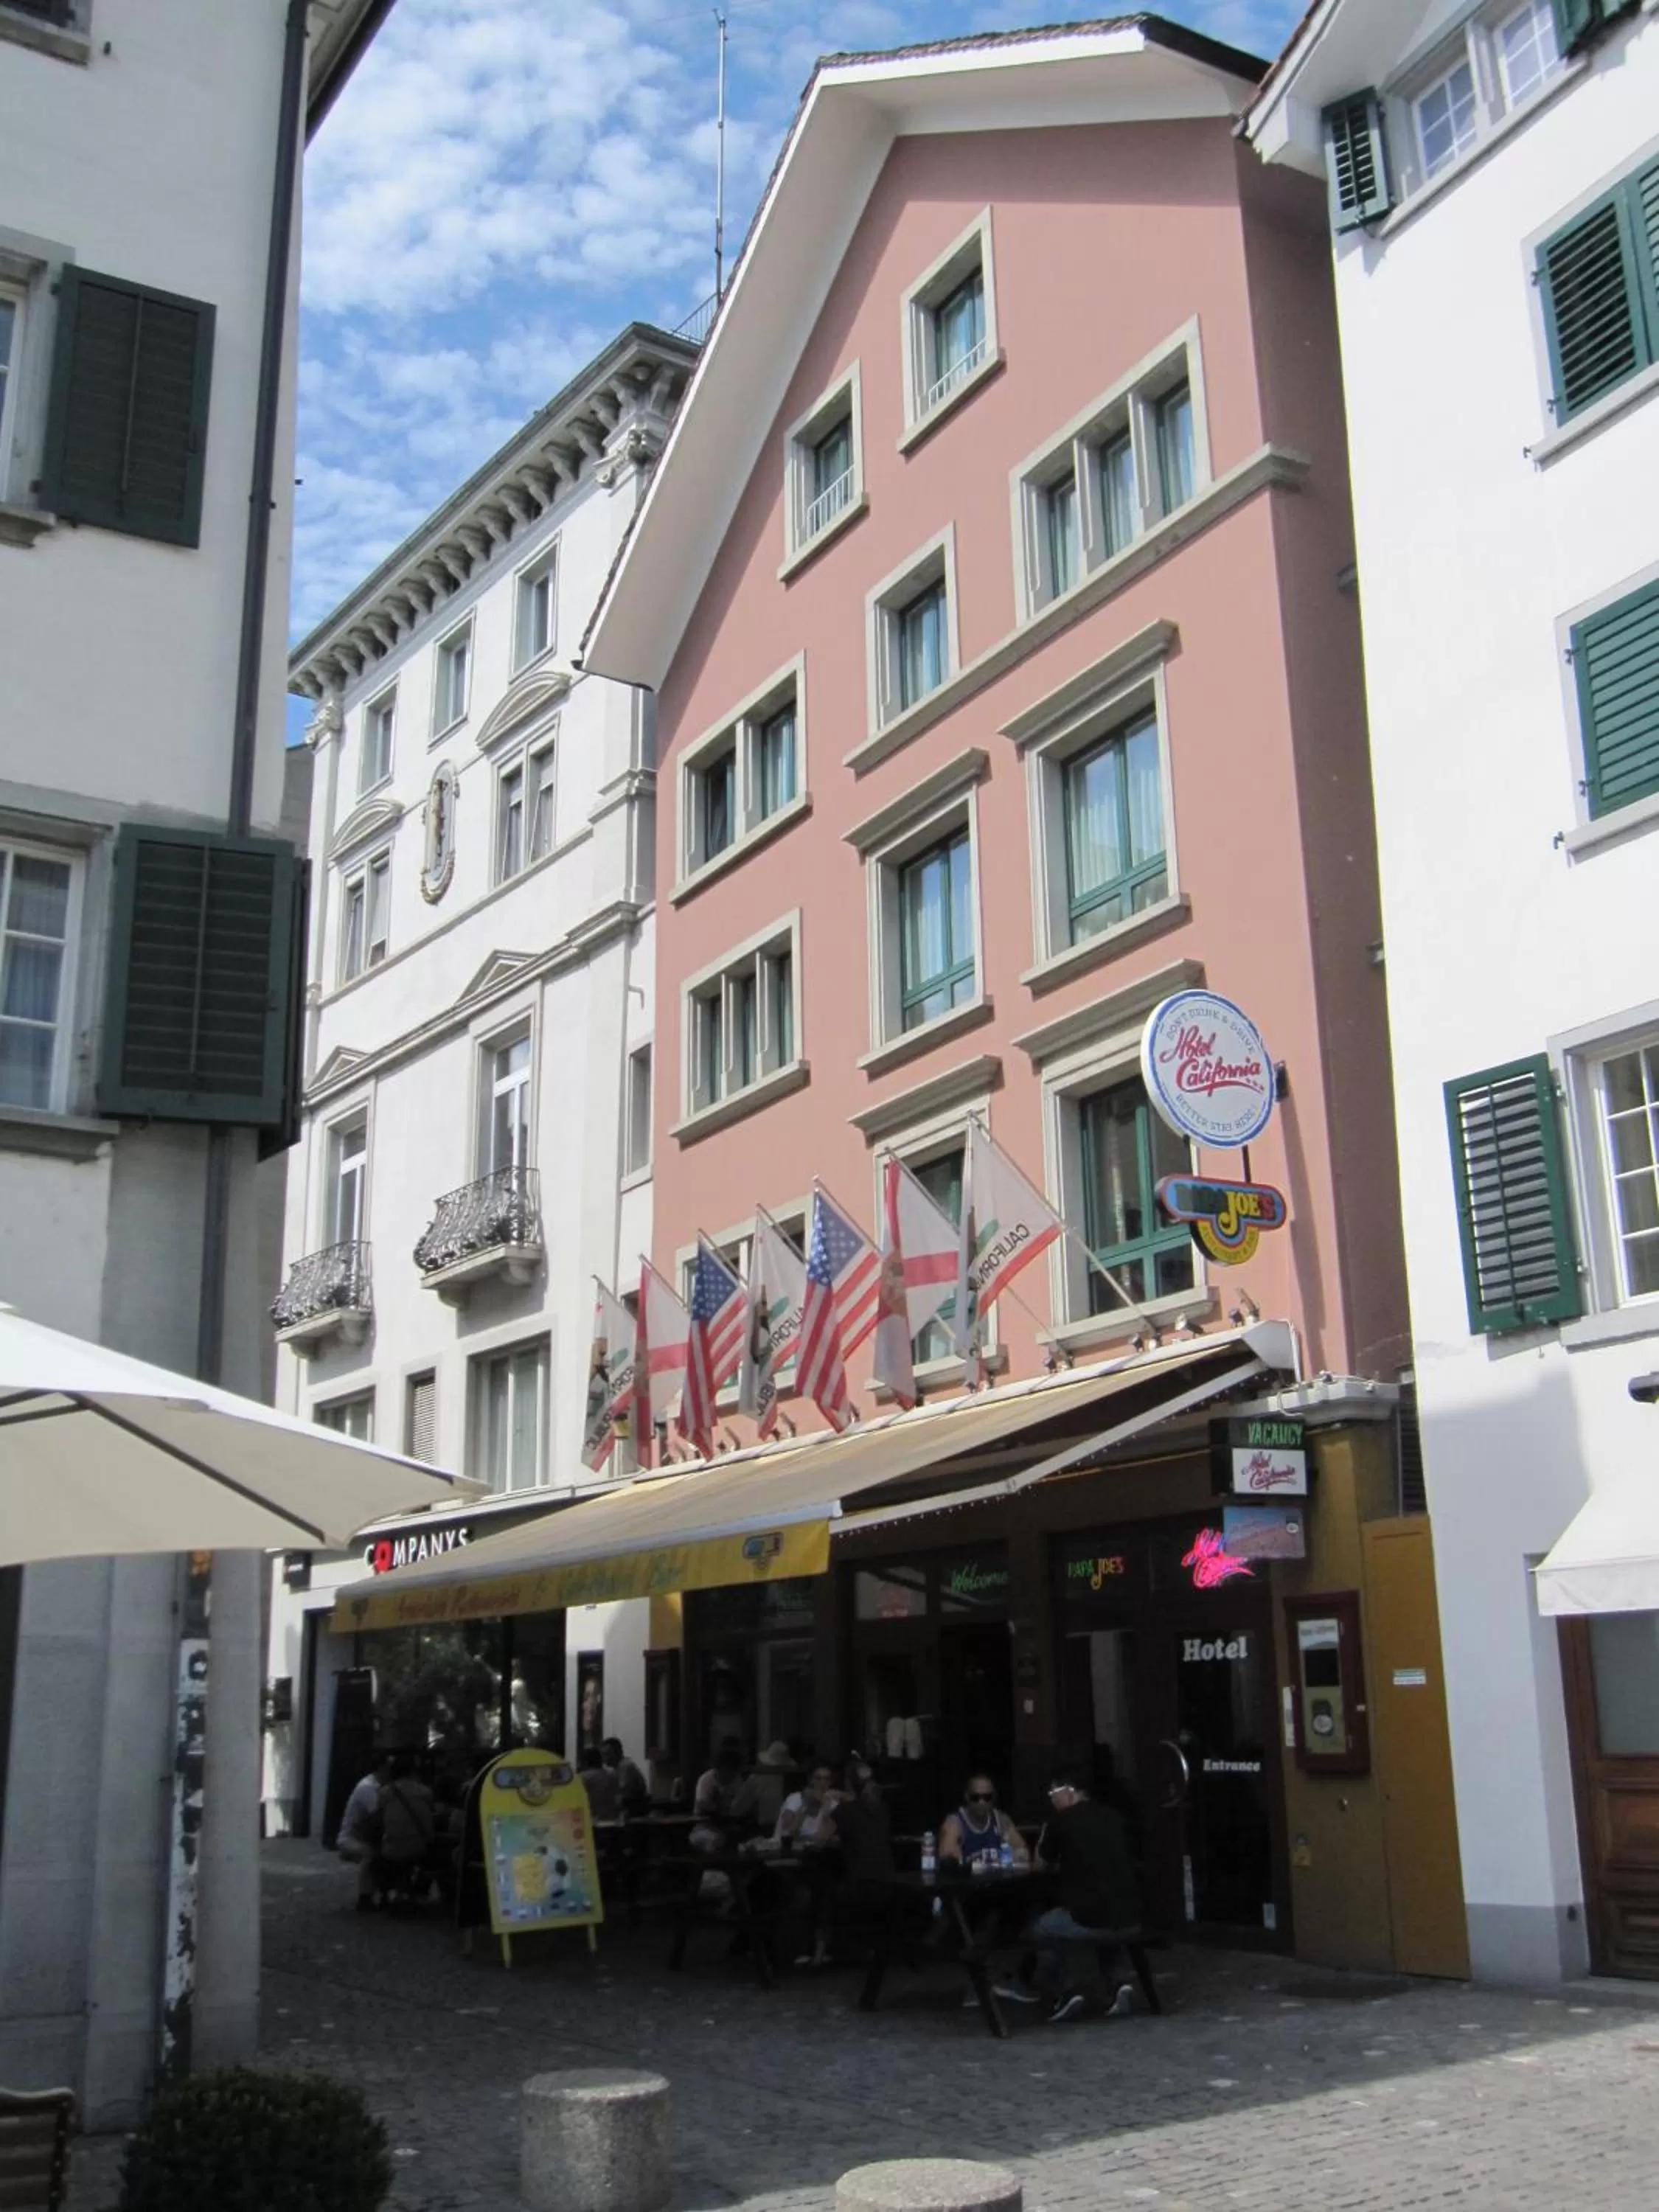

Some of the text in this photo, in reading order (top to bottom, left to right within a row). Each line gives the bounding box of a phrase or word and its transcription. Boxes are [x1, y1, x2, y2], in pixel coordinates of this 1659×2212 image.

[1159, 1024, 1217, 1064] Hotel
[1175, 1055, 1265, 1097] California
[1248, 1422, 1303, 1446] VACANCY
[950, 1560, 1009, 1594] Welcome
[1182, 1635, 1248, 1662] Hotel
[1202, 1759, 1261, 1773] Entrance
